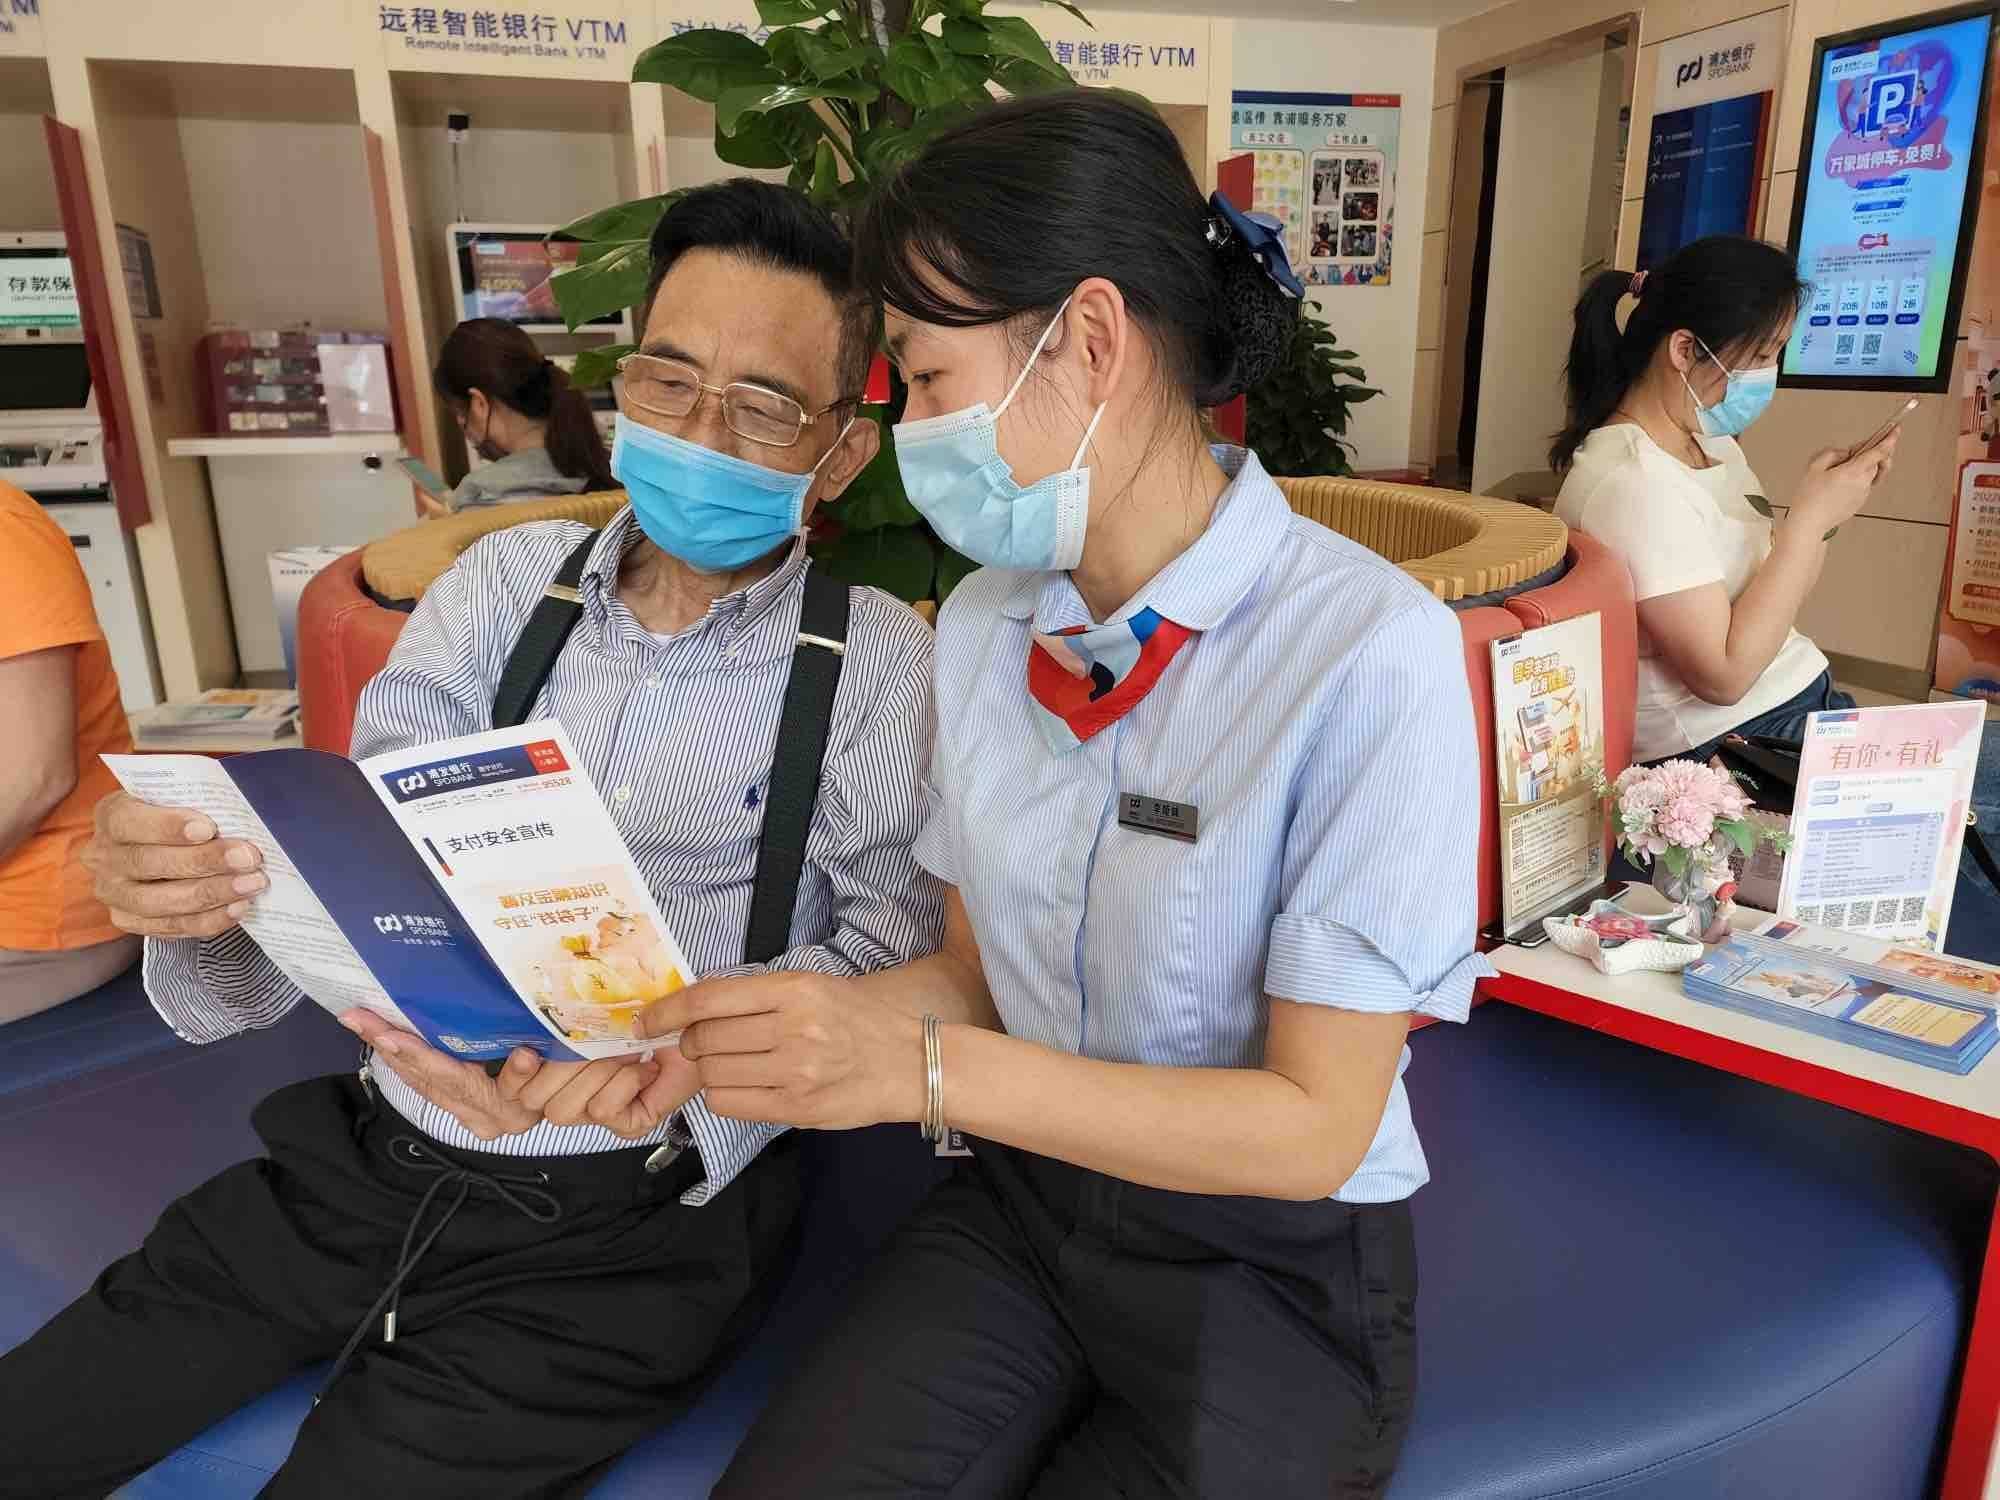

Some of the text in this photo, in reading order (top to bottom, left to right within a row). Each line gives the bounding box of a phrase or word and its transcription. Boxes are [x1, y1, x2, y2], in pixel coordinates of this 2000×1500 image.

[380, 6, 627, 44] 远程智能银行 VTM
[405, 36, 606, 59] Remote Intelligent Bank VTM
[1044, 39, 1195, 69] 智能银行 VTM
[1876, 82, 1905, 124] P
[426, 761, 472, 779] 浦发银行
[446, 821, 555, 854] 支付安全宣传
